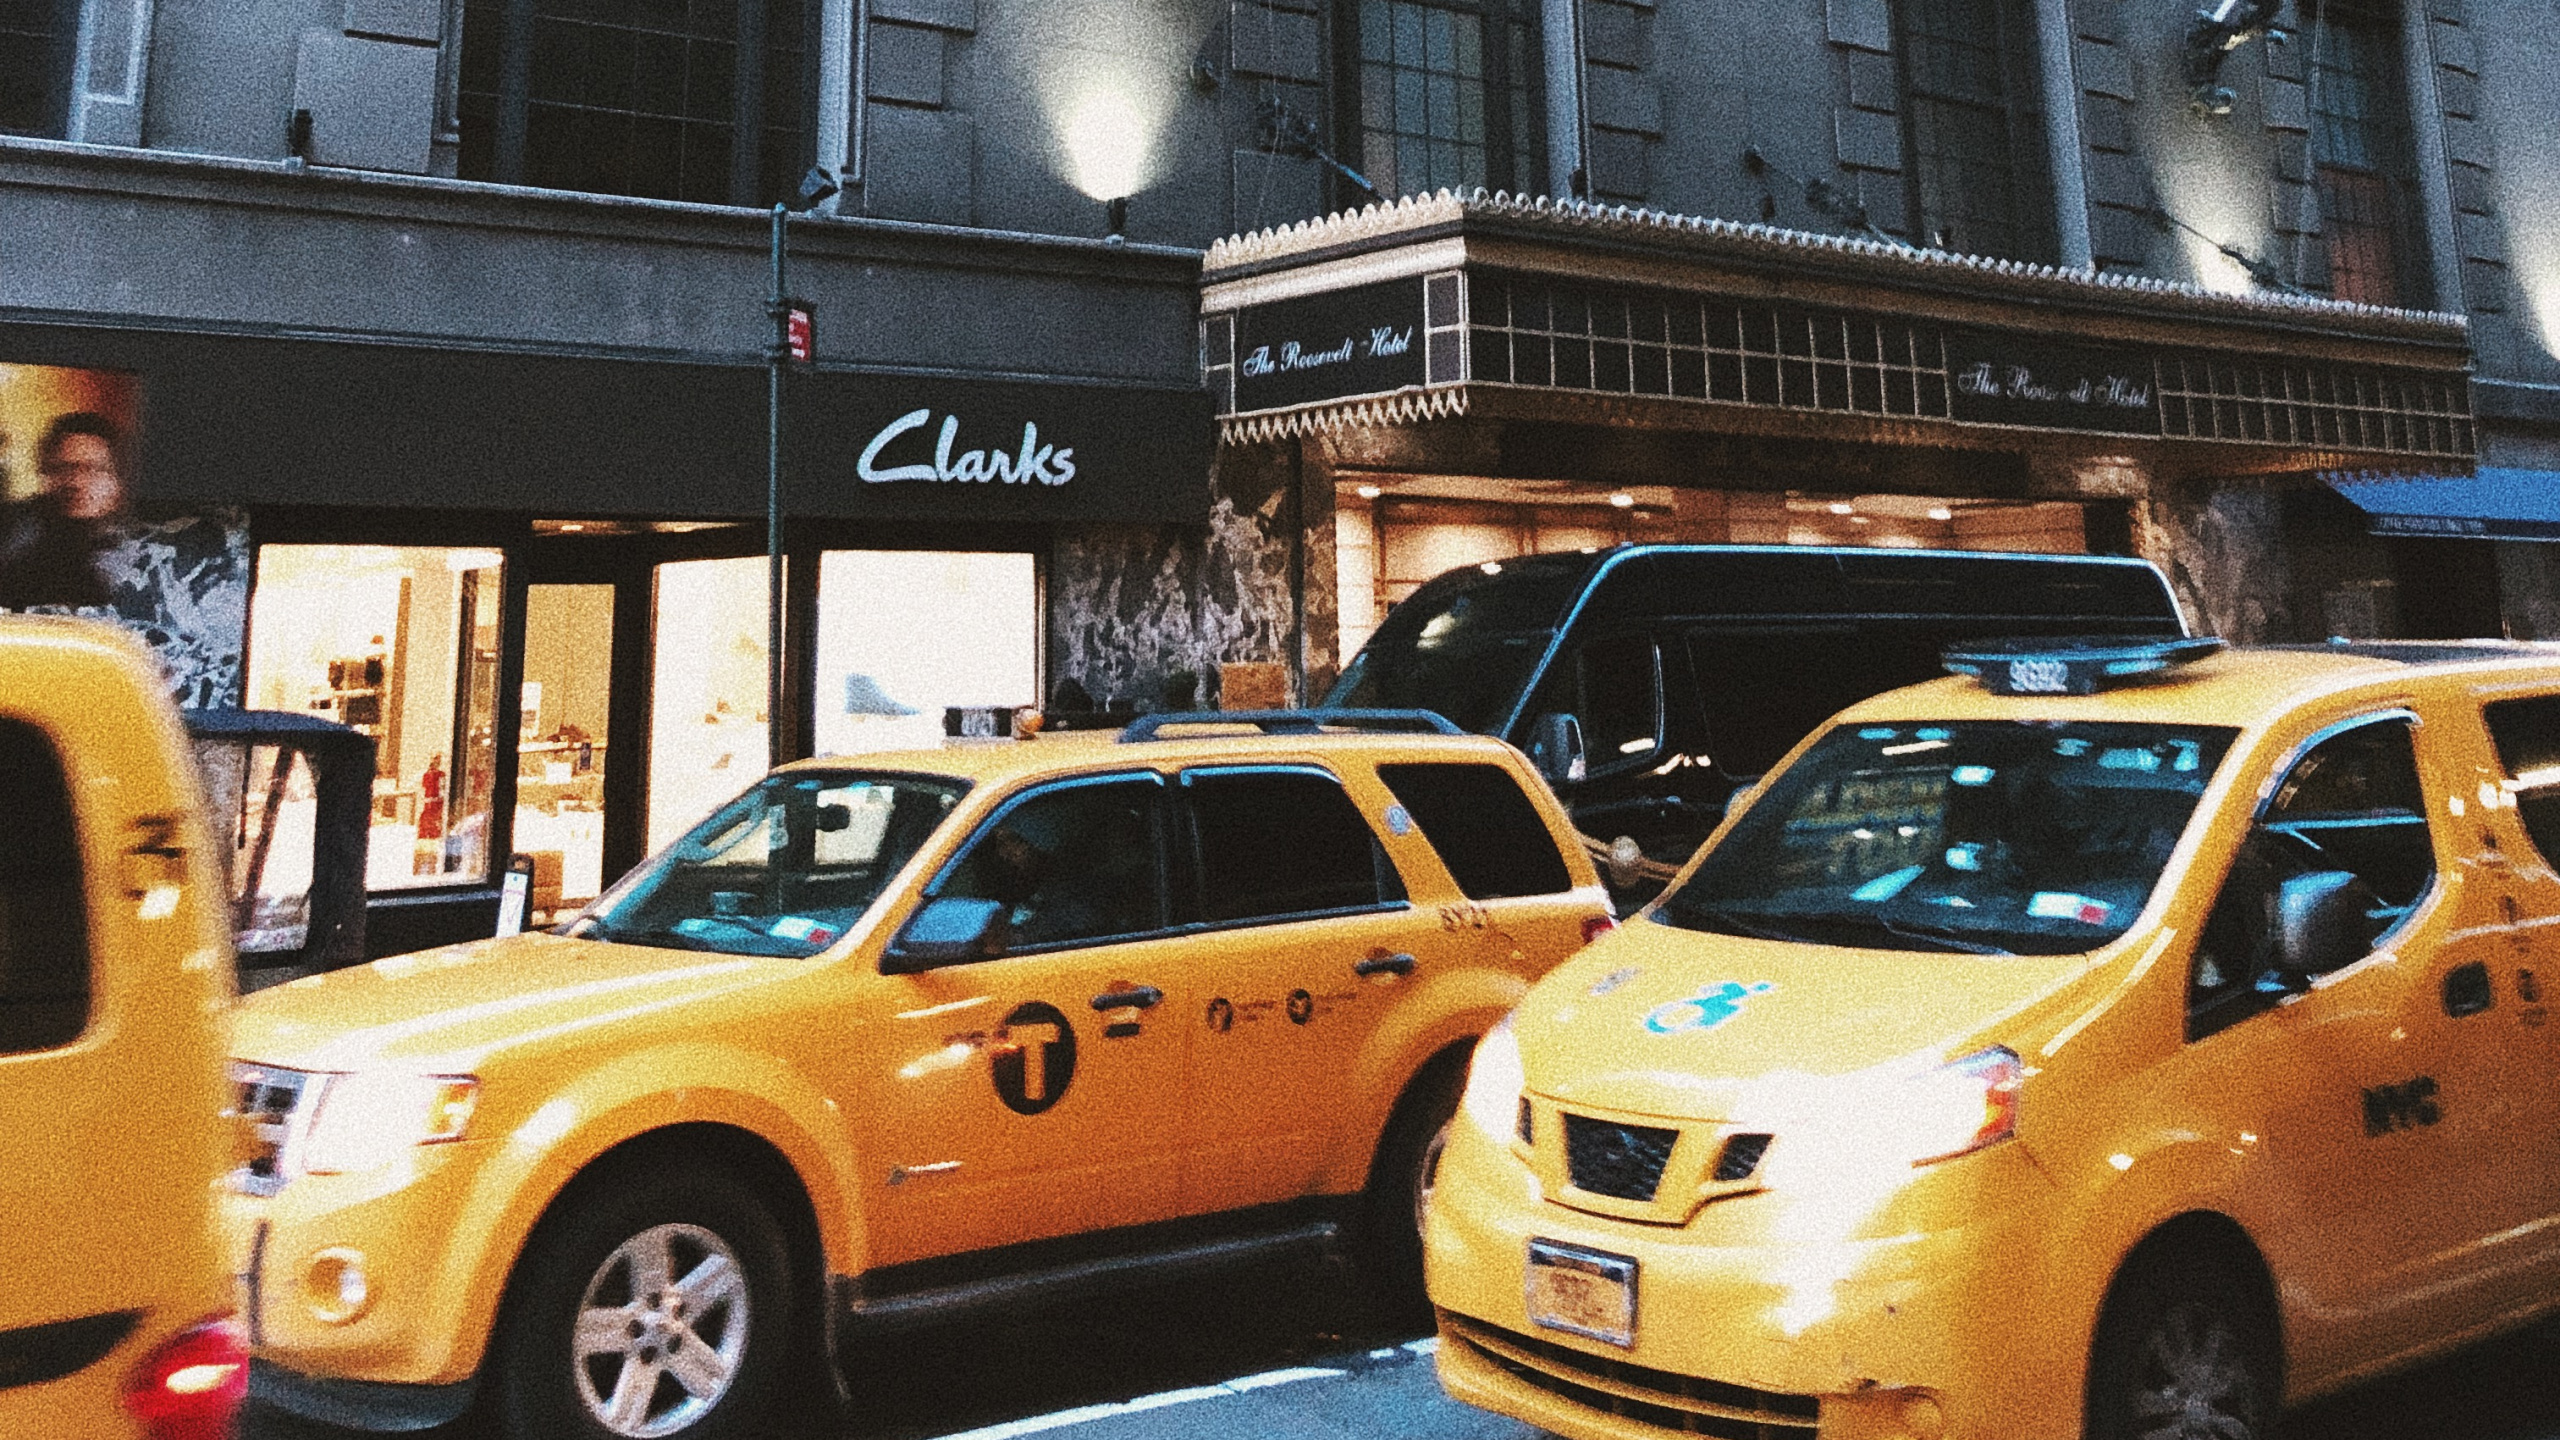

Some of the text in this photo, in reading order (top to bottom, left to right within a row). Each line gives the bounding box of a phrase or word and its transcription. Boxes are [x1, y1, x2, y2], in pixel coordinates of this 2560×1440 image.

[1243, 325, 1413, 377] The Roosevelt Hotel
[1958, 361, 2000, 396] The
[856, 408, 1076, 486] Clarks
